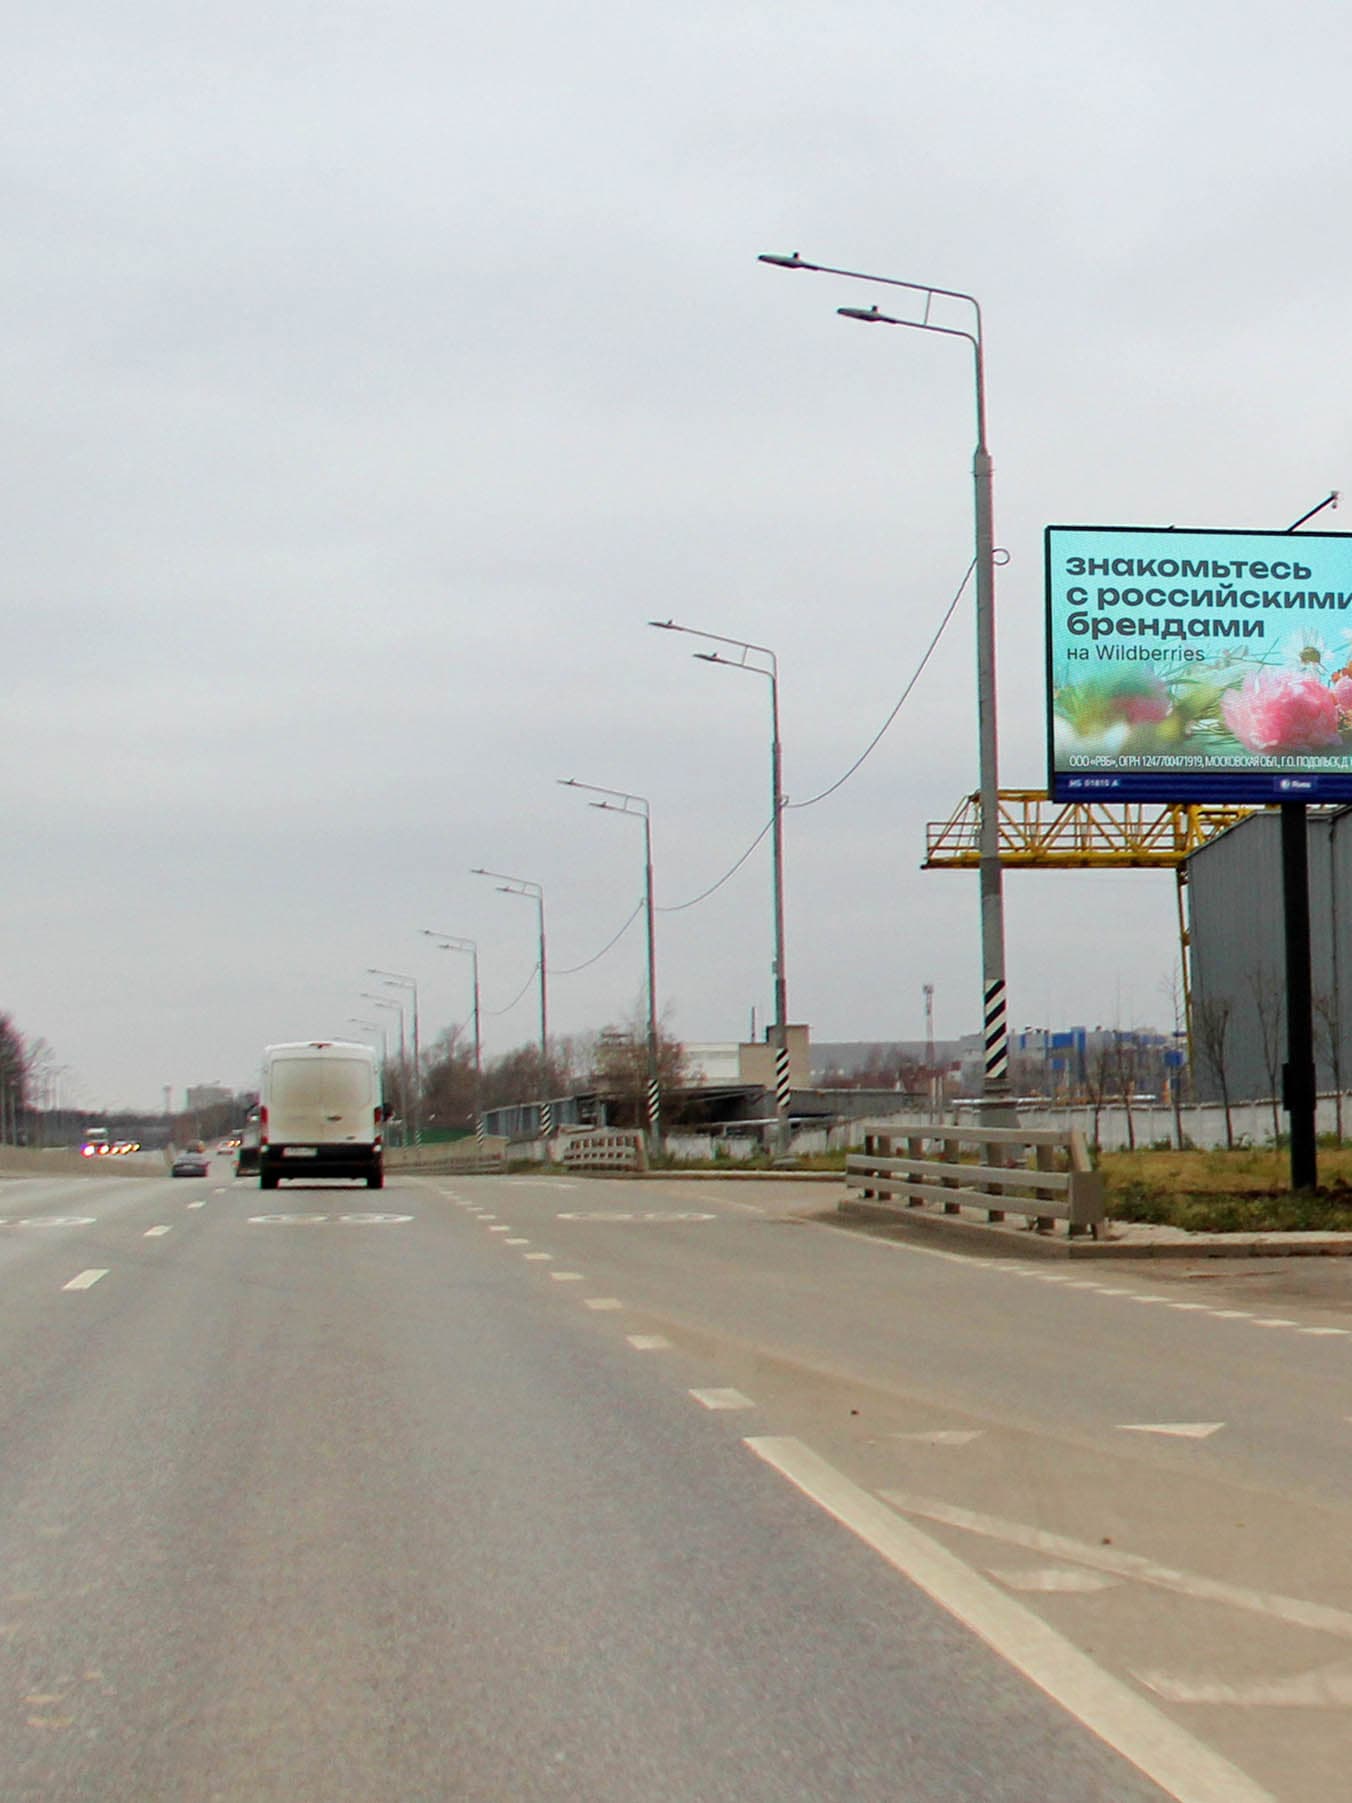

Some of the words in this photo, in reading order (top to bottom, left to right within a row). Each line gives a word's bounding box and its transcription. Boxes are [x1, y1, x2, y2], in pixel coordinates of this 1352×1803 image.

[1066, 556, 1312, 580] знакомьтесь
[1066, 587, 1088, 606] с
[1067, 611, 1264, 640] брендами
[1067, 648, 1089, 660] на
[1096, 645, 1205, 662] Wildberries
[1069, 755, 1089, 767] ООО
[1119, 755, 1140, 767] ОГРН
[1205, 755, 1259, 768] МОСКОВСКАЯ
